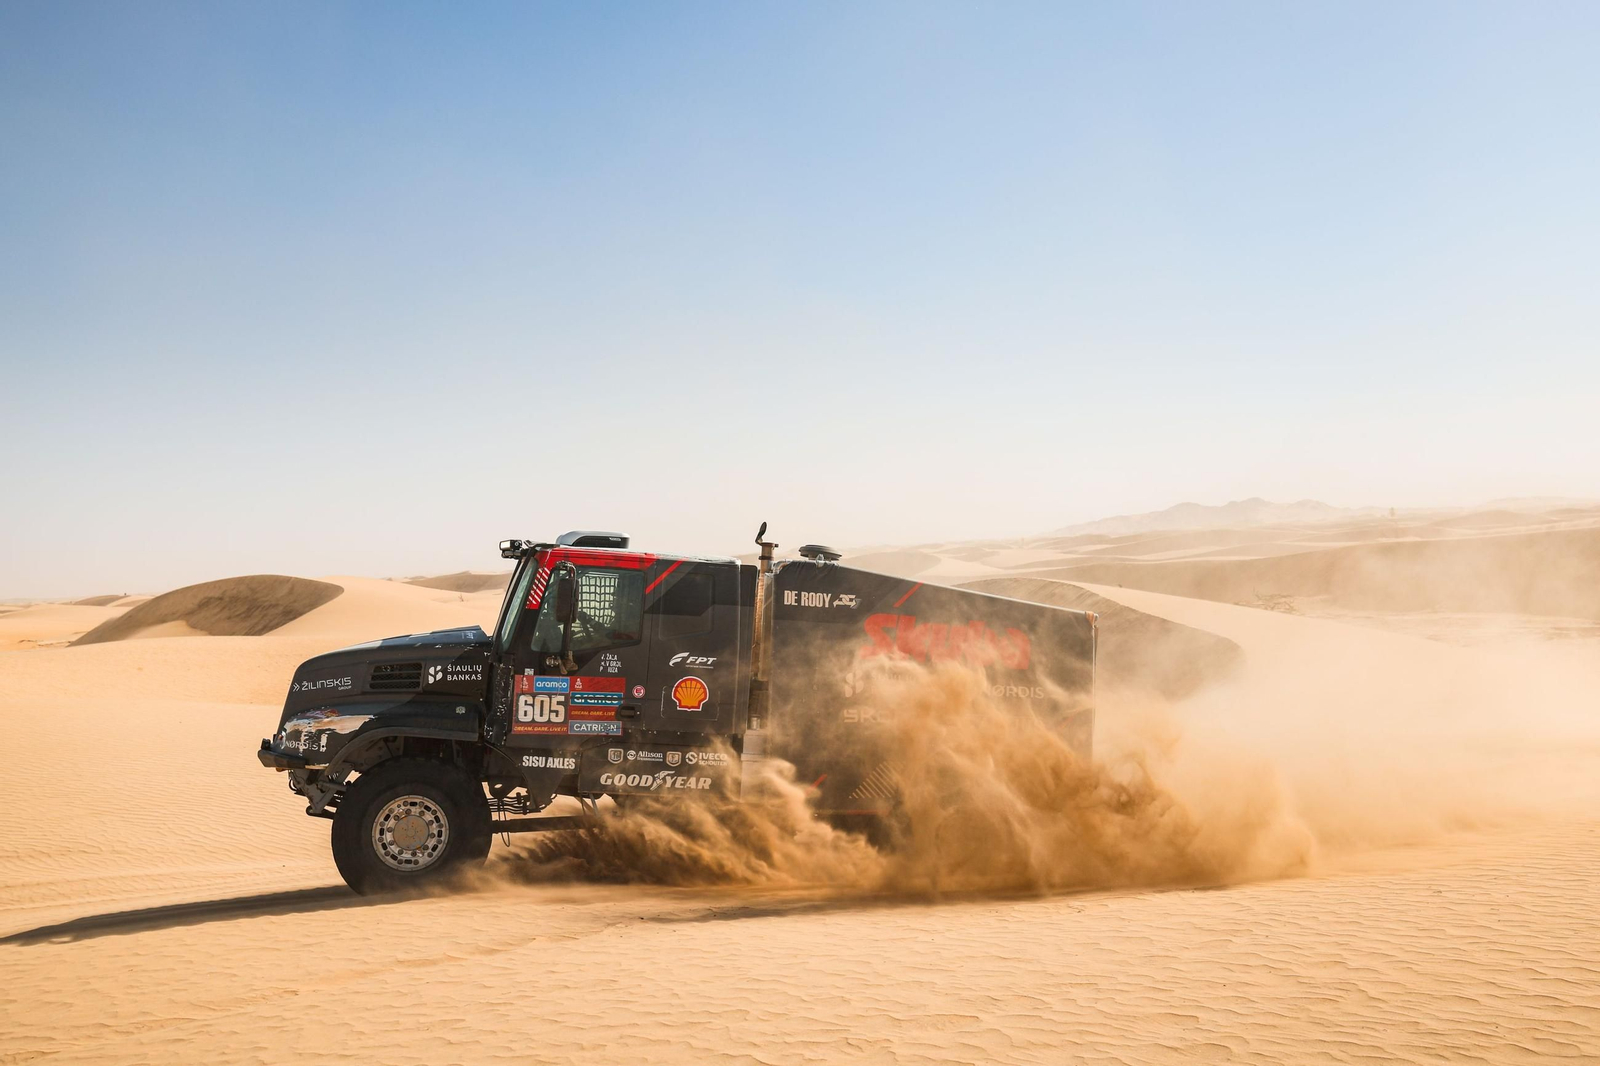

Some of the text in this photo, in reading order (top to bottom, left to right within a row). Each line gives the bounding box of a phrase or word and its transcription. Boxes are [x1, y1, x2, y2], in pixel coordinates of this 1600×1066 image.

[784, 590, 831, 608] DE ROOY
[686, 656, 717, 665] FPT
[447, 664, 482, 672] ŠIAULIŲ
[536, 681, 568, 689] aramco
[986, 684, 1045, 699] ØRDIS
[518, 694, 565, 723] 605
[637, 750, 663, 759] Allison
[699, 752, 728, 760] IVECO
[522, 755, 575, 769] SISU AXLES
